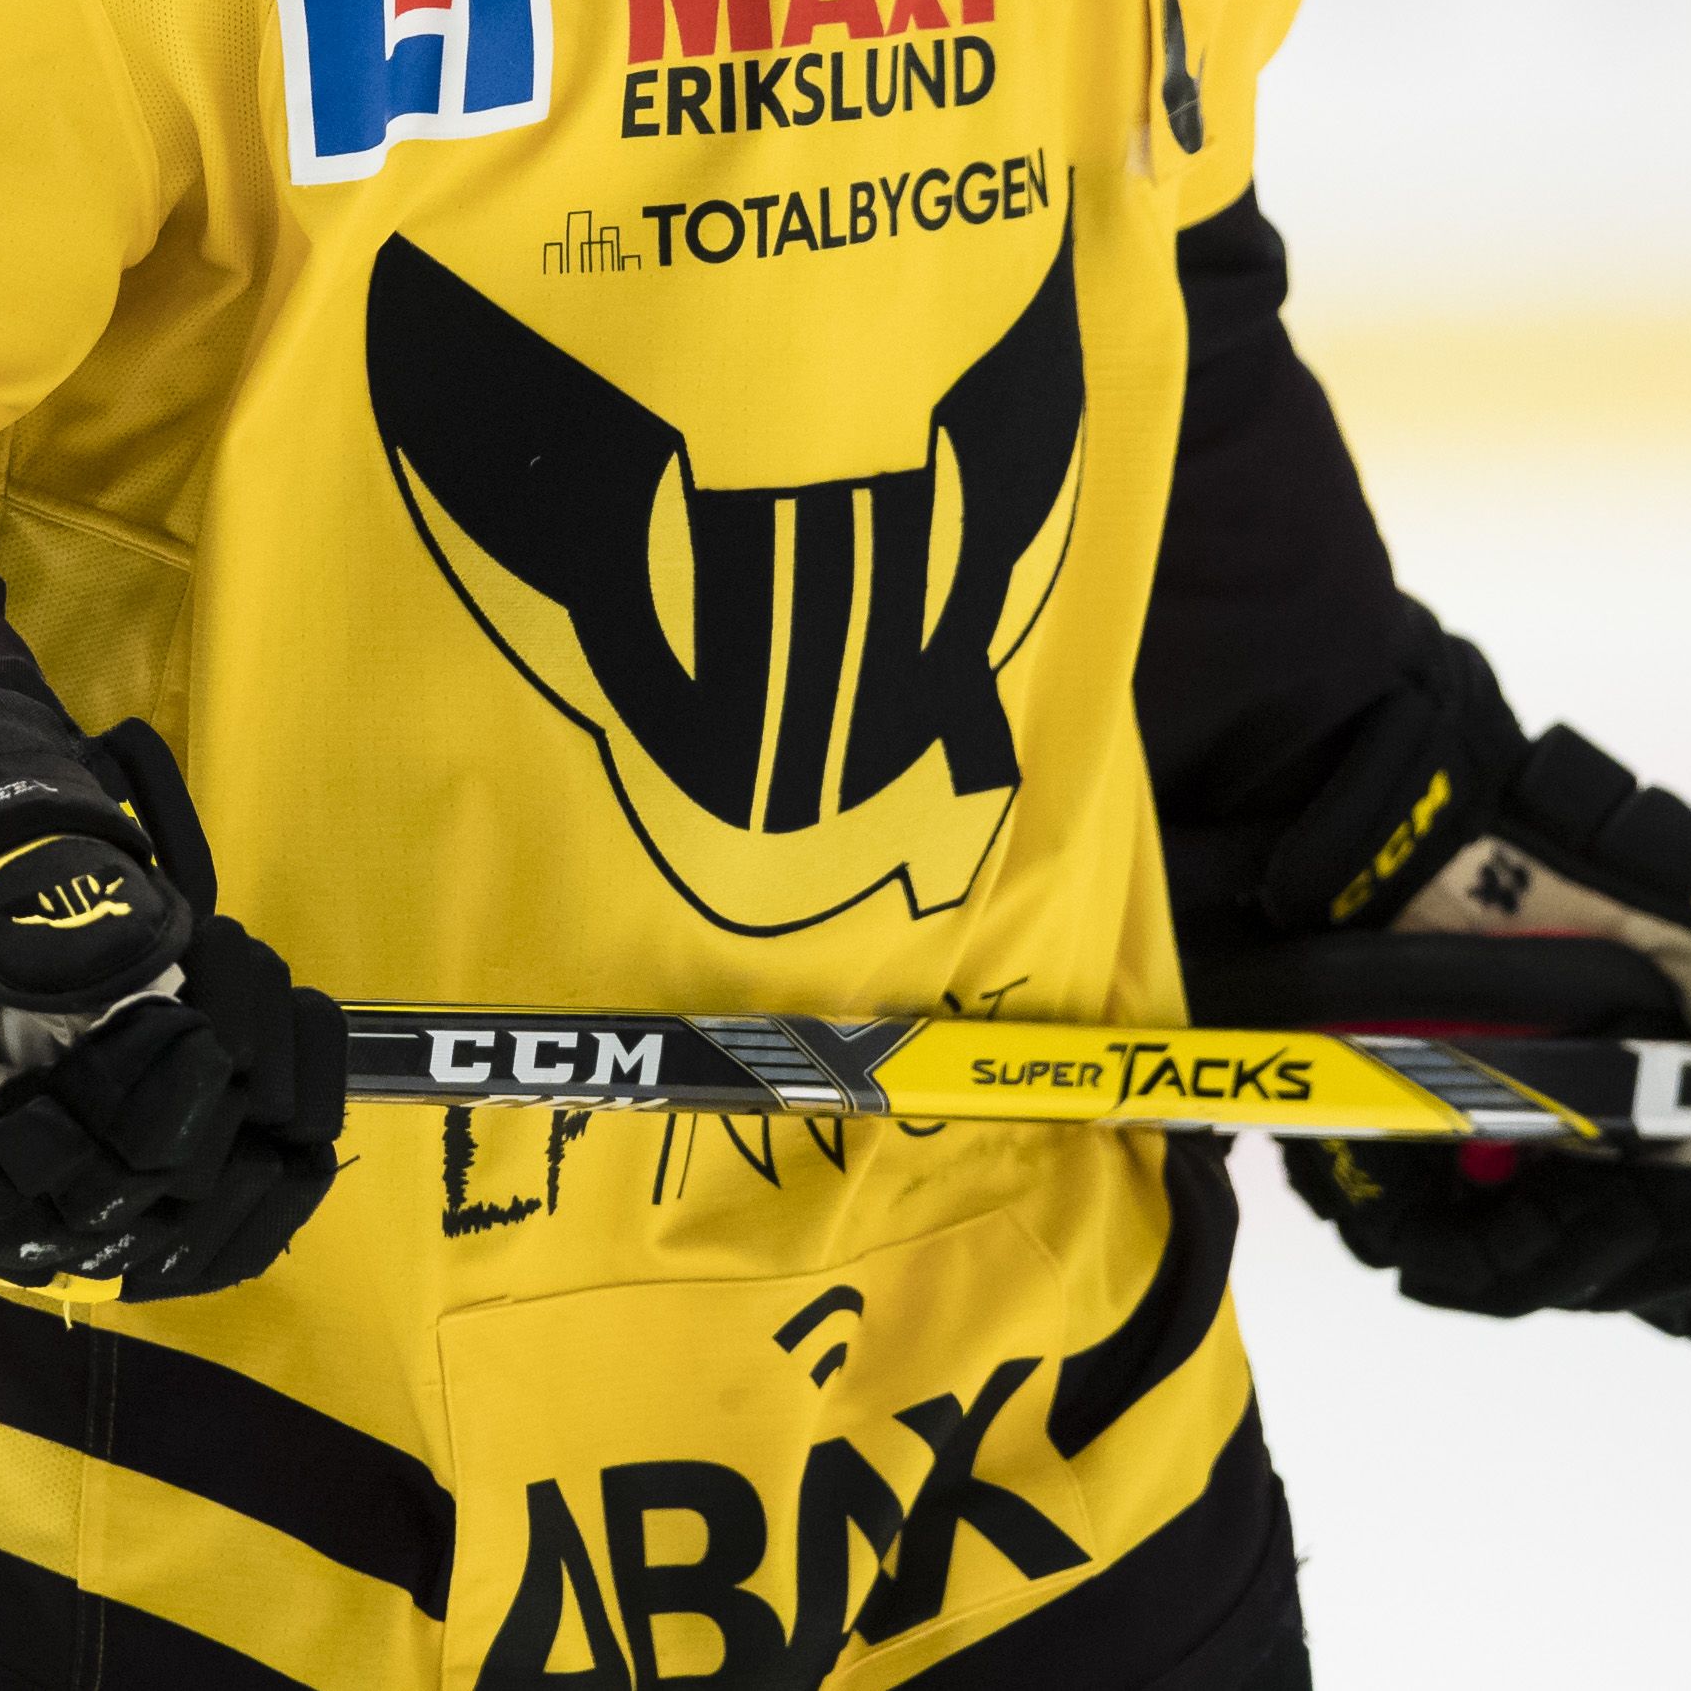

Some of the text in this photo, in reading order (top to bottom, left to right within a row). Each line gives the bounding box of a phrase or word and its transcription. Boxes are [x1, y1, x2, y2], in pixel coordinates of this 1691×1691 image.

[621, 35, 996, 139] ERIKSLUND
[642, 147, 1049, 266] TOTALBYGGEN
[425, 1029, 664, 1086] CCM
[971, 1042, 1314, 1109] SUPER TACKS
[471, 1356, 1095, 1691] ABAX
